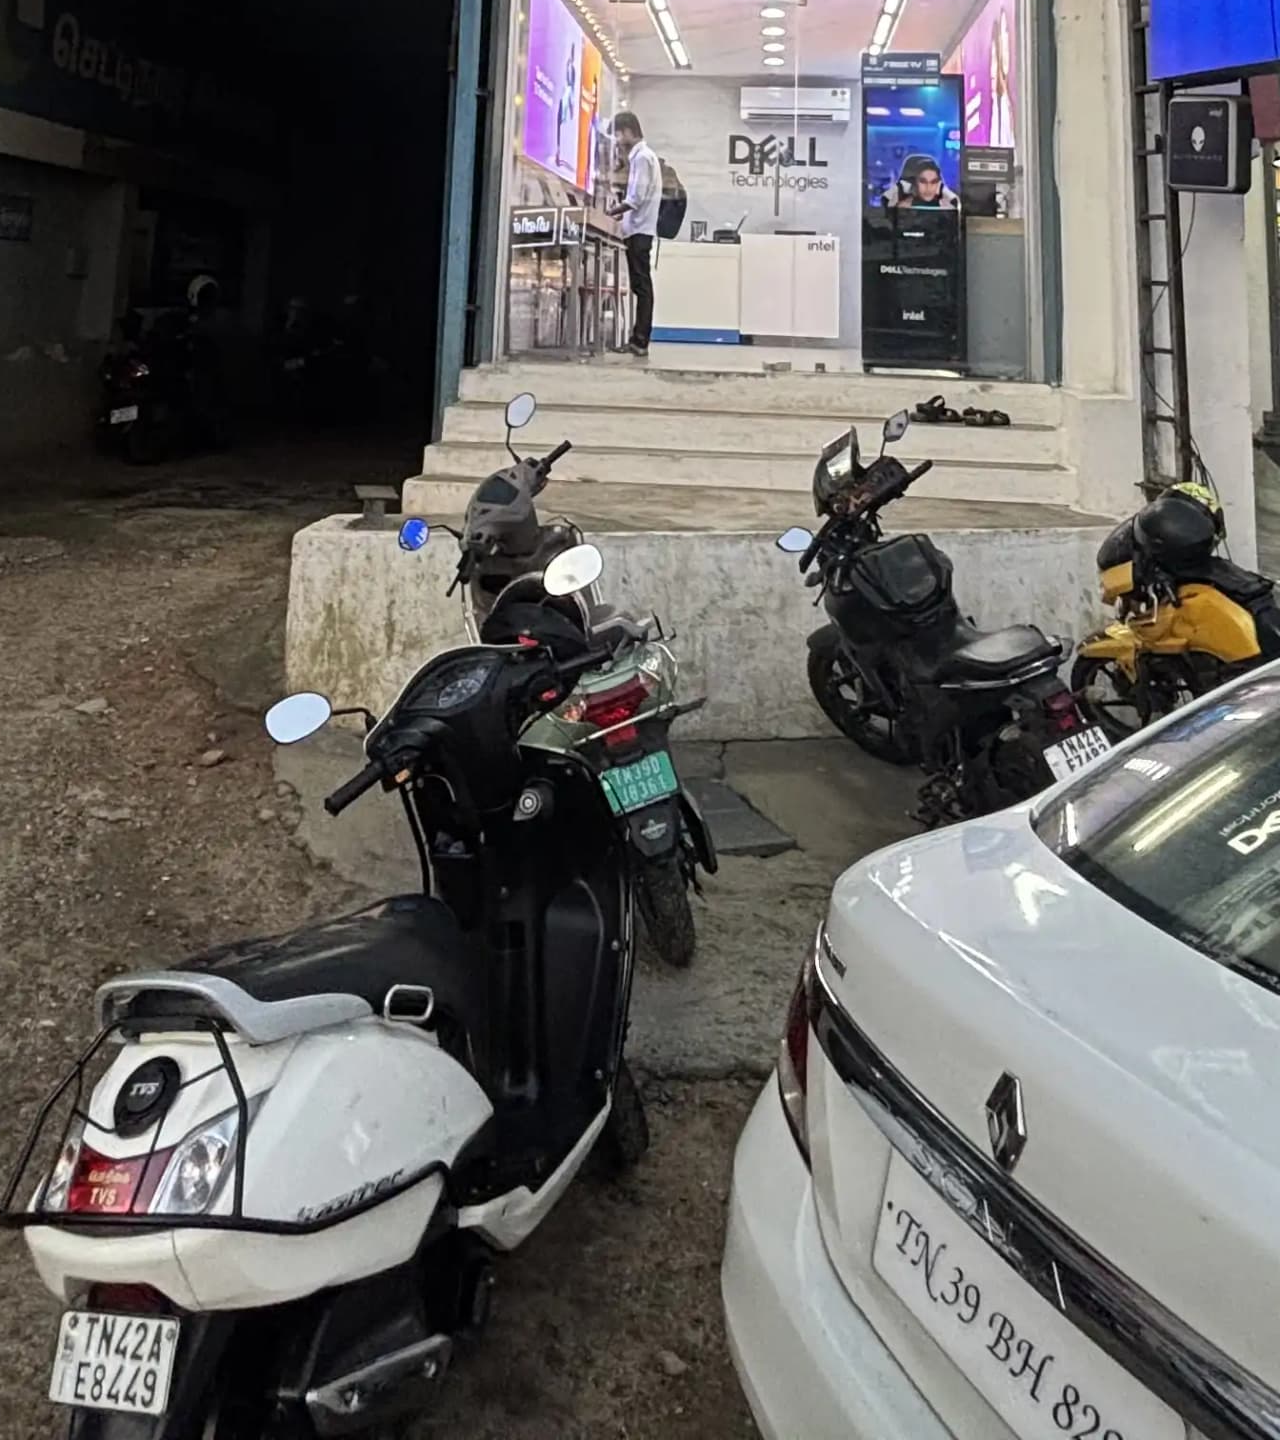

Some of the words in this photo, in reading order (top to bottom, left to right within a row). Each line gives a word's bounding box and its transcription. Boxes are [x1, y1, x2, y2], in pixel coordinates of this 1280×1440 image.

[728, 133, 828, 168] DELL
[731, 171, 828, 192] Technologies
[808, 239, 835, 252] intel
[880, 265, 902, 274] DELL
[130, 1081, 159, 1097] TVS
[90, 1187, 116, 1206] TVS
[942, 1265, 980, 1324] 39
[84, 1316, 162, 1363] TN42A
[73, 1364, 158, 1408] E8449
